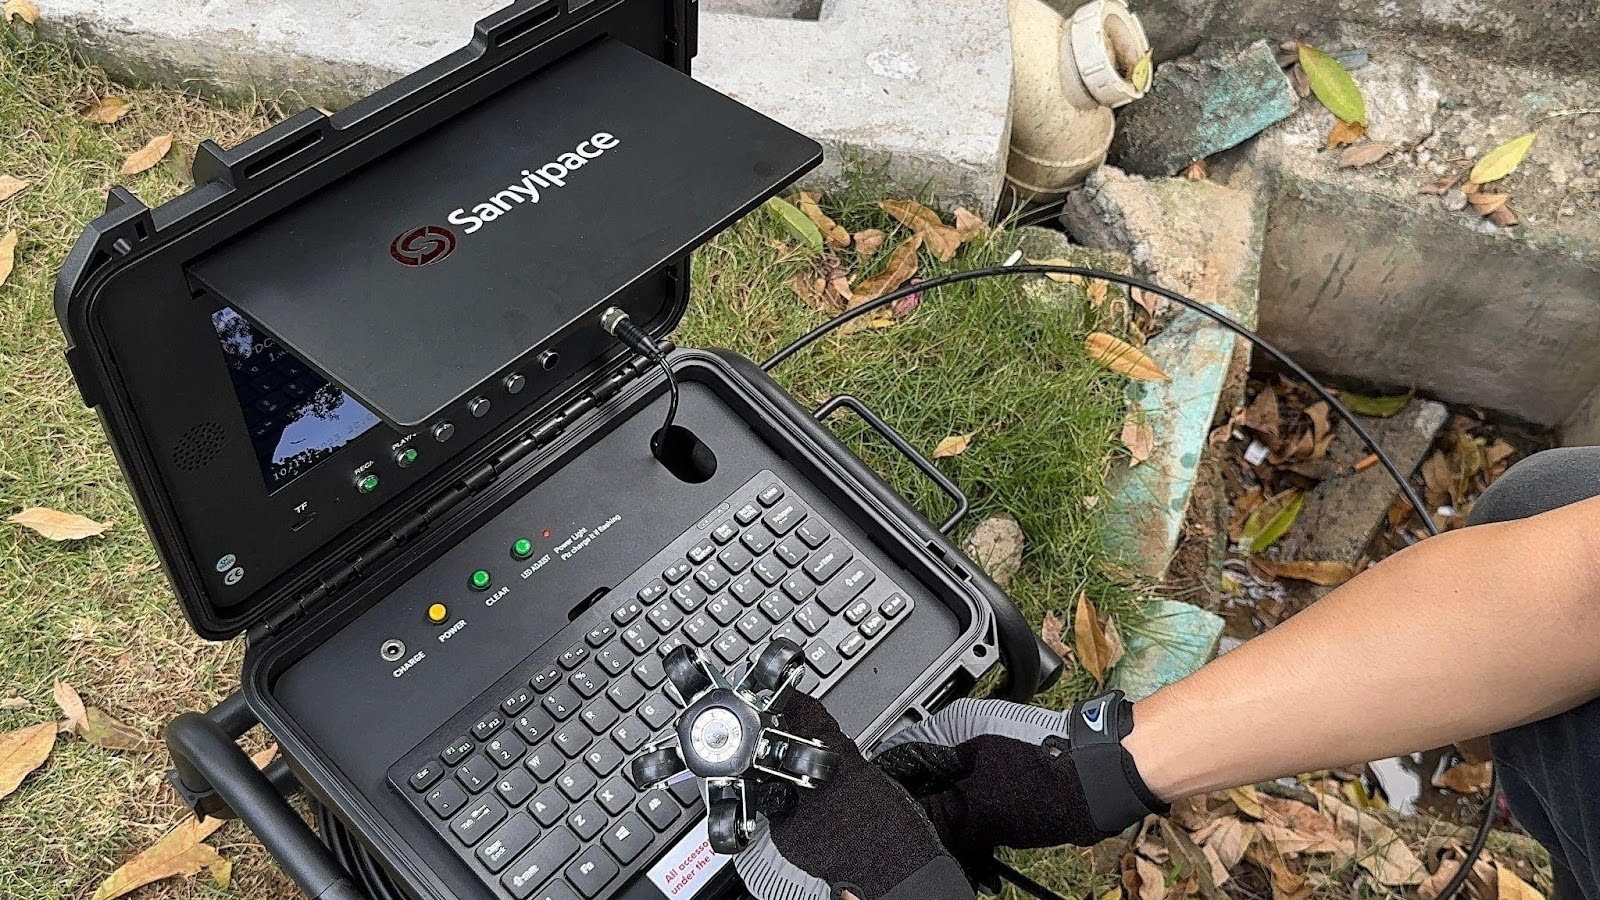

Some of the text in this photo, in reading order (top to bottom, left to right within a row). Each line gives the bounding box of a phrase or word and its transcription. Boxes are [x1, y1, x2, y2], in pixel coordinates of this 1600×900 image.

[448, 131, 620, 234] Sanyipace
[294, 501, 308, 513] TF
[553, 527, 588, 554] Power Light
[560, 551, 572, 561] Plz
[571, 536, 592, 554] charge
[598, 514, 622, 532] flashing
[520, 554, 551, 579] LED ADJUST
[228, 568, 243, 583] CE
[485, 586, 510, 607] CLEAR
[438, 619, 467, 642] POWER
[393, 650, 426, 678] CHARGE
[585, 711, 597, 720] R
[645, 705, 655, 715] G
[558, 733, 568, 742] E
[618, 728, 628, 739] F
[529, 755, 541, 767] W
[590, 752, 602, 763] D
[500, 781, 514, 791] Q
[563, 776, 575, 787] S
[602, 789, 615, 802] X
[535, 802, 547, 812] A
[574, 814, 587, 827] Z
[665, 868, 679, 883] All
[671, 855, 711, 895] under the
